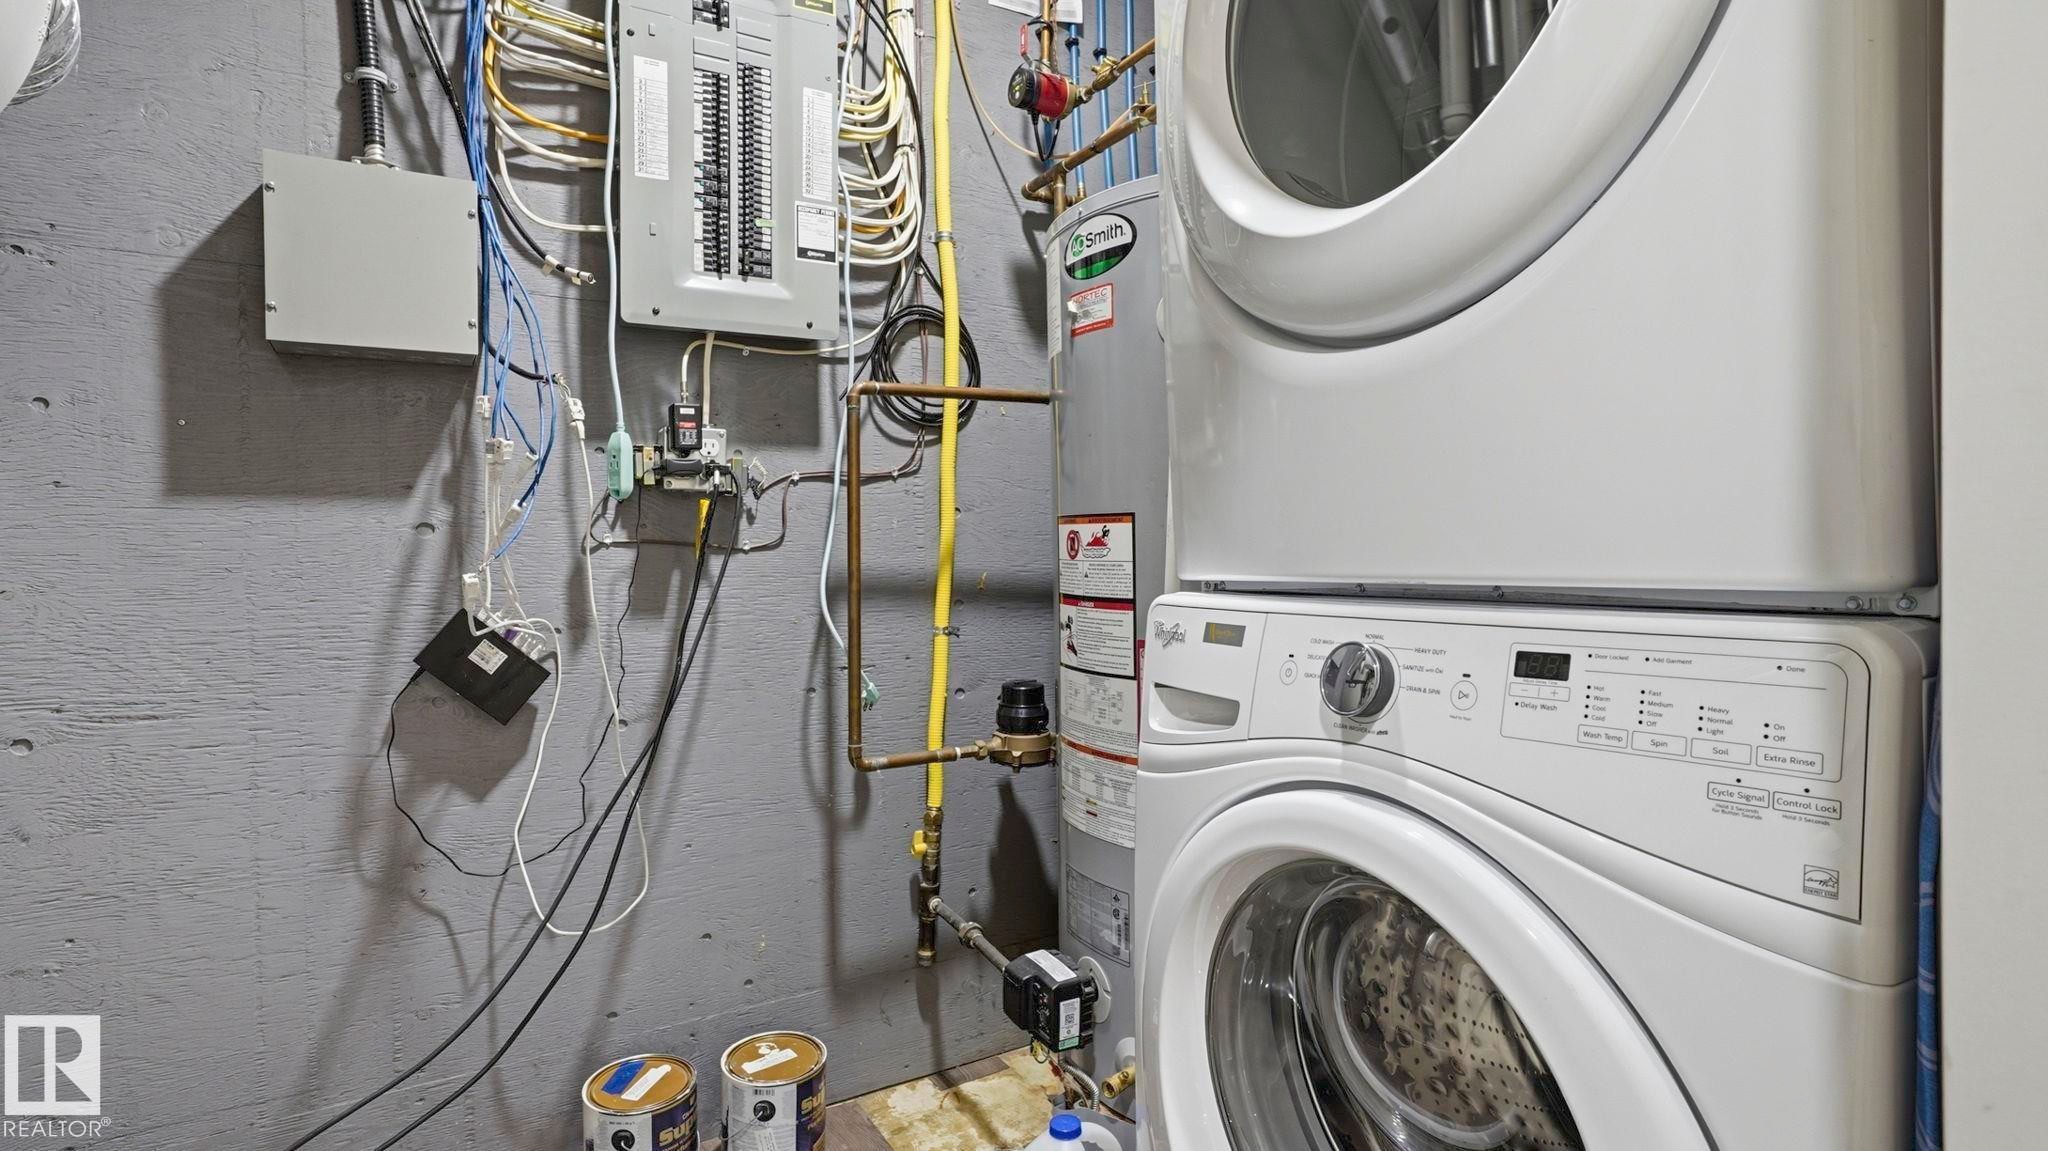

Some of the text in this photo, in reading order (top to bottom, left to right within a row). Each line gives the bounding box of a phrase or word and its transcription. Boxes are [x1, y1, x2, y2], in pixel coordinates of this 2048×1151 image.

[1085, 223, 1123, 248] Smith
[1154, 620, 1186, 648] Whirlpool
[1402, 664, 1424, 672] SANITIZE
[1786, 665, 1806, 673] Done
[1406, 685, 1422, 693] DRAIN
[1520, 702, 1557, 711] Delay Wash
[1648, 700, 1674, 708] Medium
[1707, 706, 1730, 715] Heavy
[1707, 716, 1733, 725] Normal
[1706, 727, 1724, 736] Light
[1773, 723, 1785, 731] On
[1583, 730, 1623, 742] Wash Temp
[1773, 734, 1786, 742] Off
[1650, 739, 1668, 748] Spin
[1712, 746, 1729, 756] Soil
[1763, 753, 1816, 767] Extra Rinse
[1712, 787, 1765, 803] Cycle Signal
[1776, 797, 1838, 814] Control Lock
[1804, 817, 1830, 826] Seconds
